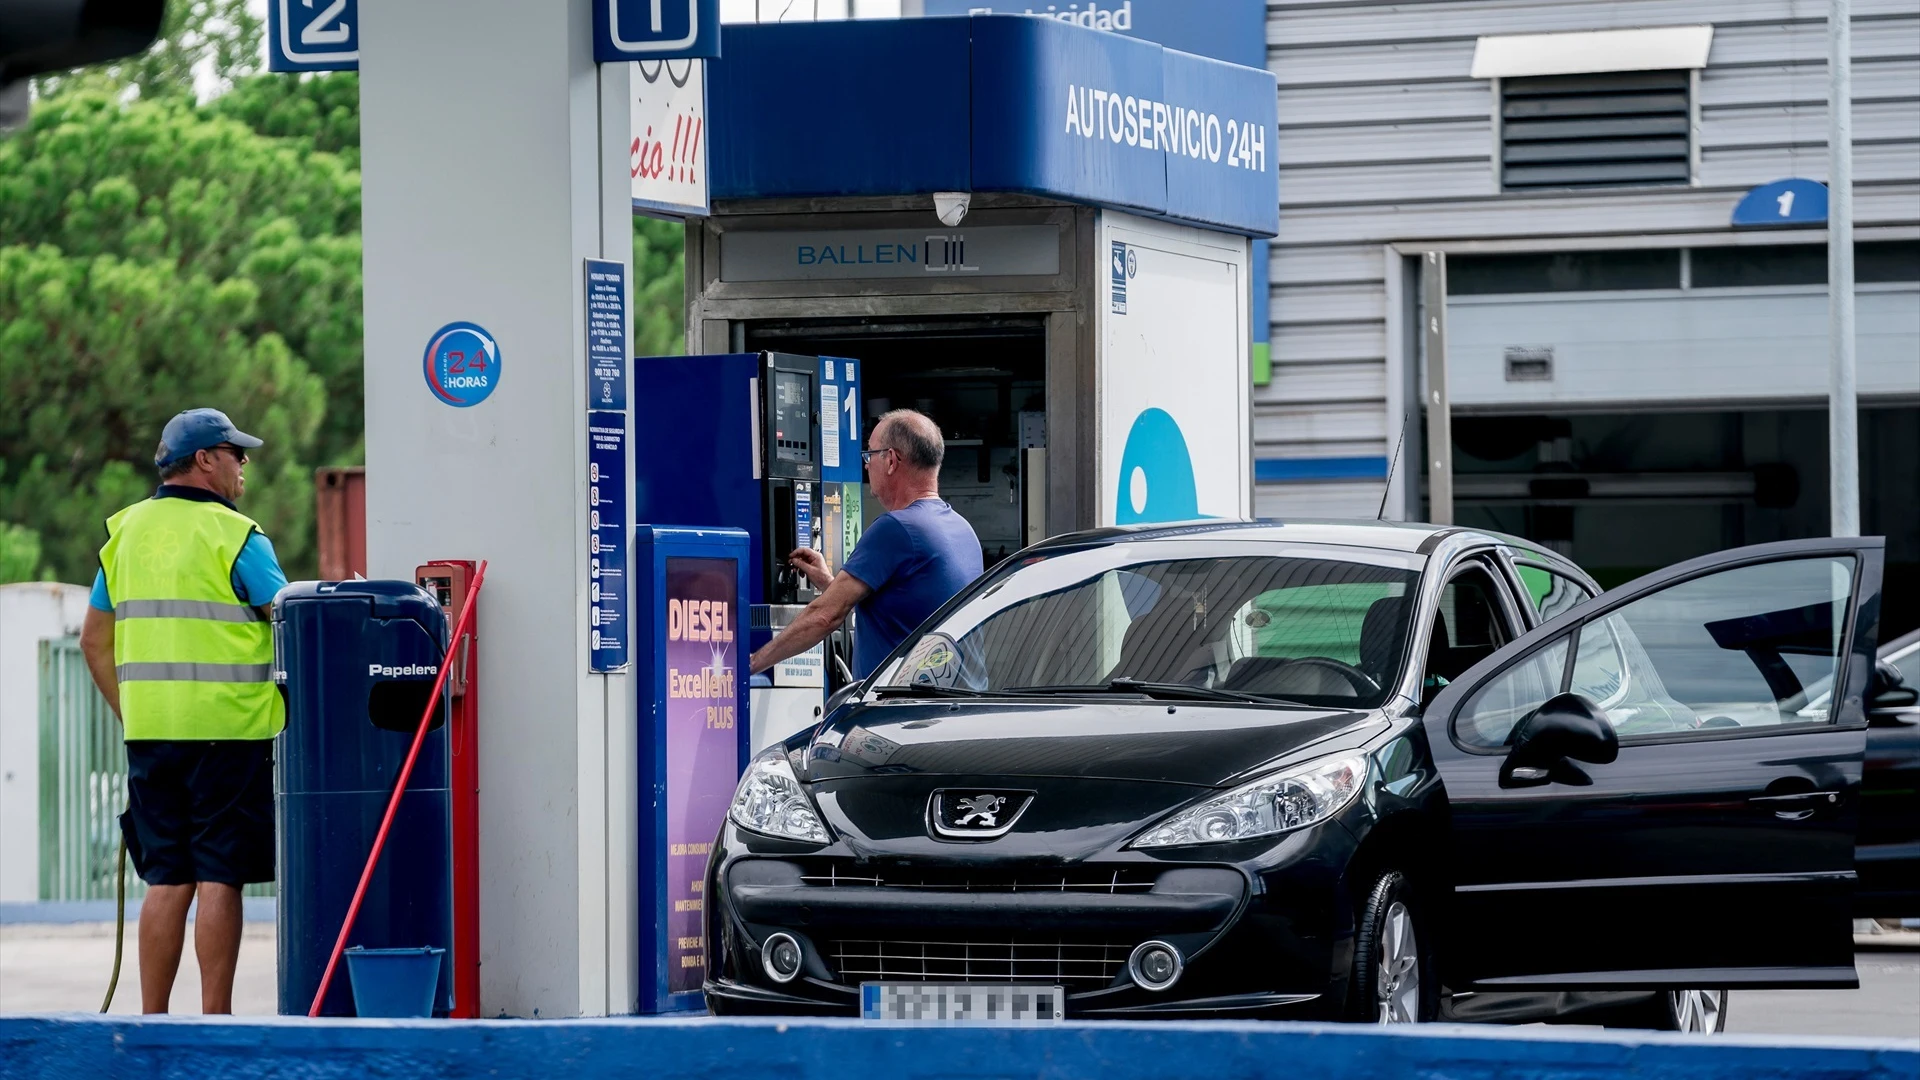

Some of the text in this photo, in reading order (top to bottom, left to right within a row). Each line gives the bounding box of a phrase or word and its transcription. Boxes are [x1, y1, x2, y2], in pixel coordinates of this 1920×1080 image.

[301, 0, 350, 45] 2
[1065, 84, 1266, 173] AUTOSERVICIO 24H
[1776, 190, 1795, 217] 1
[448, 349, 488, 374] 24
[448, 375, 488, 388] HORAS
[844, 387, 857, 440] 1
[669, 598, 734, 643] DIESEL
[369, 664, 438, 678] Papelera
[669, 668, 734, 699] Excellent
[707, 705, 734, 729] PLUS
[687, 842, 707, 855] CONSUMO
[678, 936, 699, 950] PREVIENE
